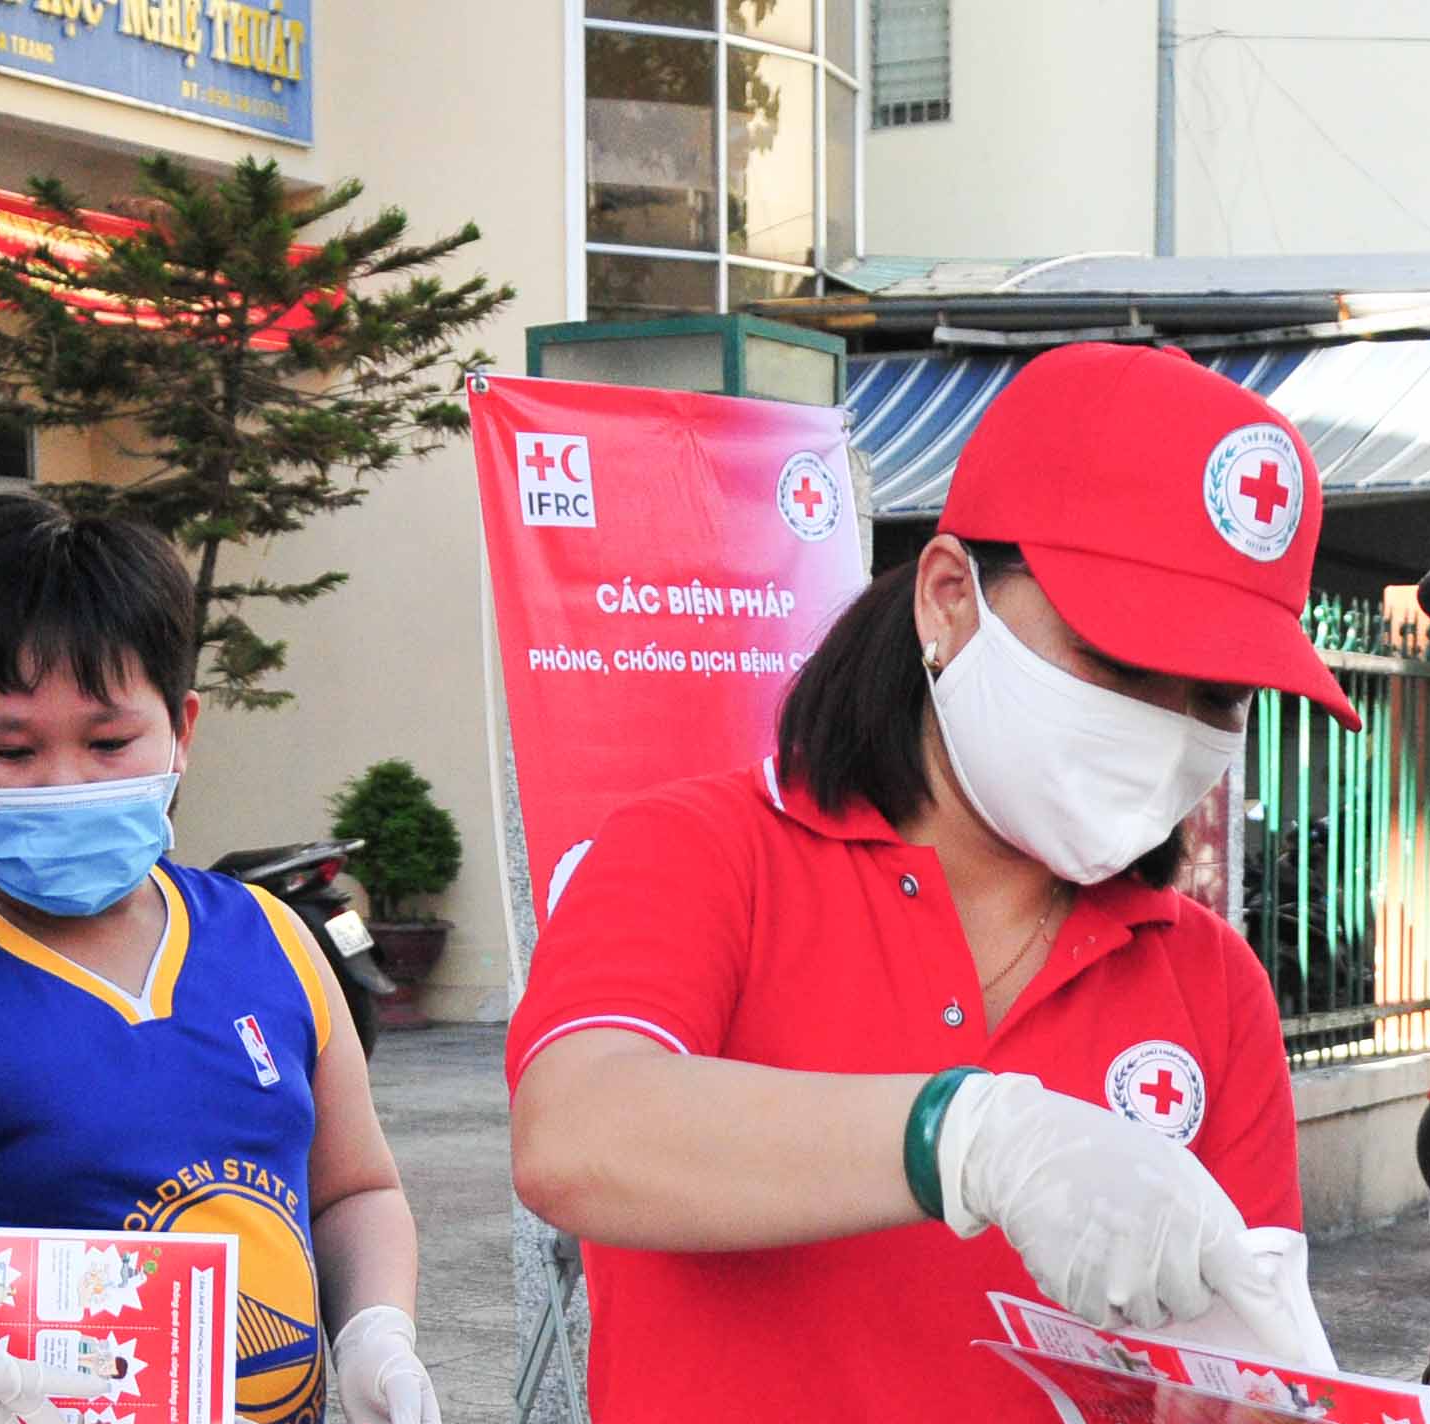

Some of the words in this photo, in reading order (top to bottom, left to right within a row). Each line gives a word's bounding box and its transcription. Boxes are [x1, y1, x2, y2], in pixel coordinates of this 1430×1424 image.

[527, 491, 590, 518] IFRC
[596, 576, 661, 614] CÁC
[667, 578, 724, 624] BIỆN
[729, 581, 796, 618] PHÁP
[528, 644, 609, 675] PHÒNG,
[614, 642, 686, 672] CHỐNG
[690, 650, 736, 678] DỊCH
[740, 647, 784, 678] BỆNH
[123, 1160, 215, 1232] OLDEN
[223, 1158, 299, 1214] STATE
